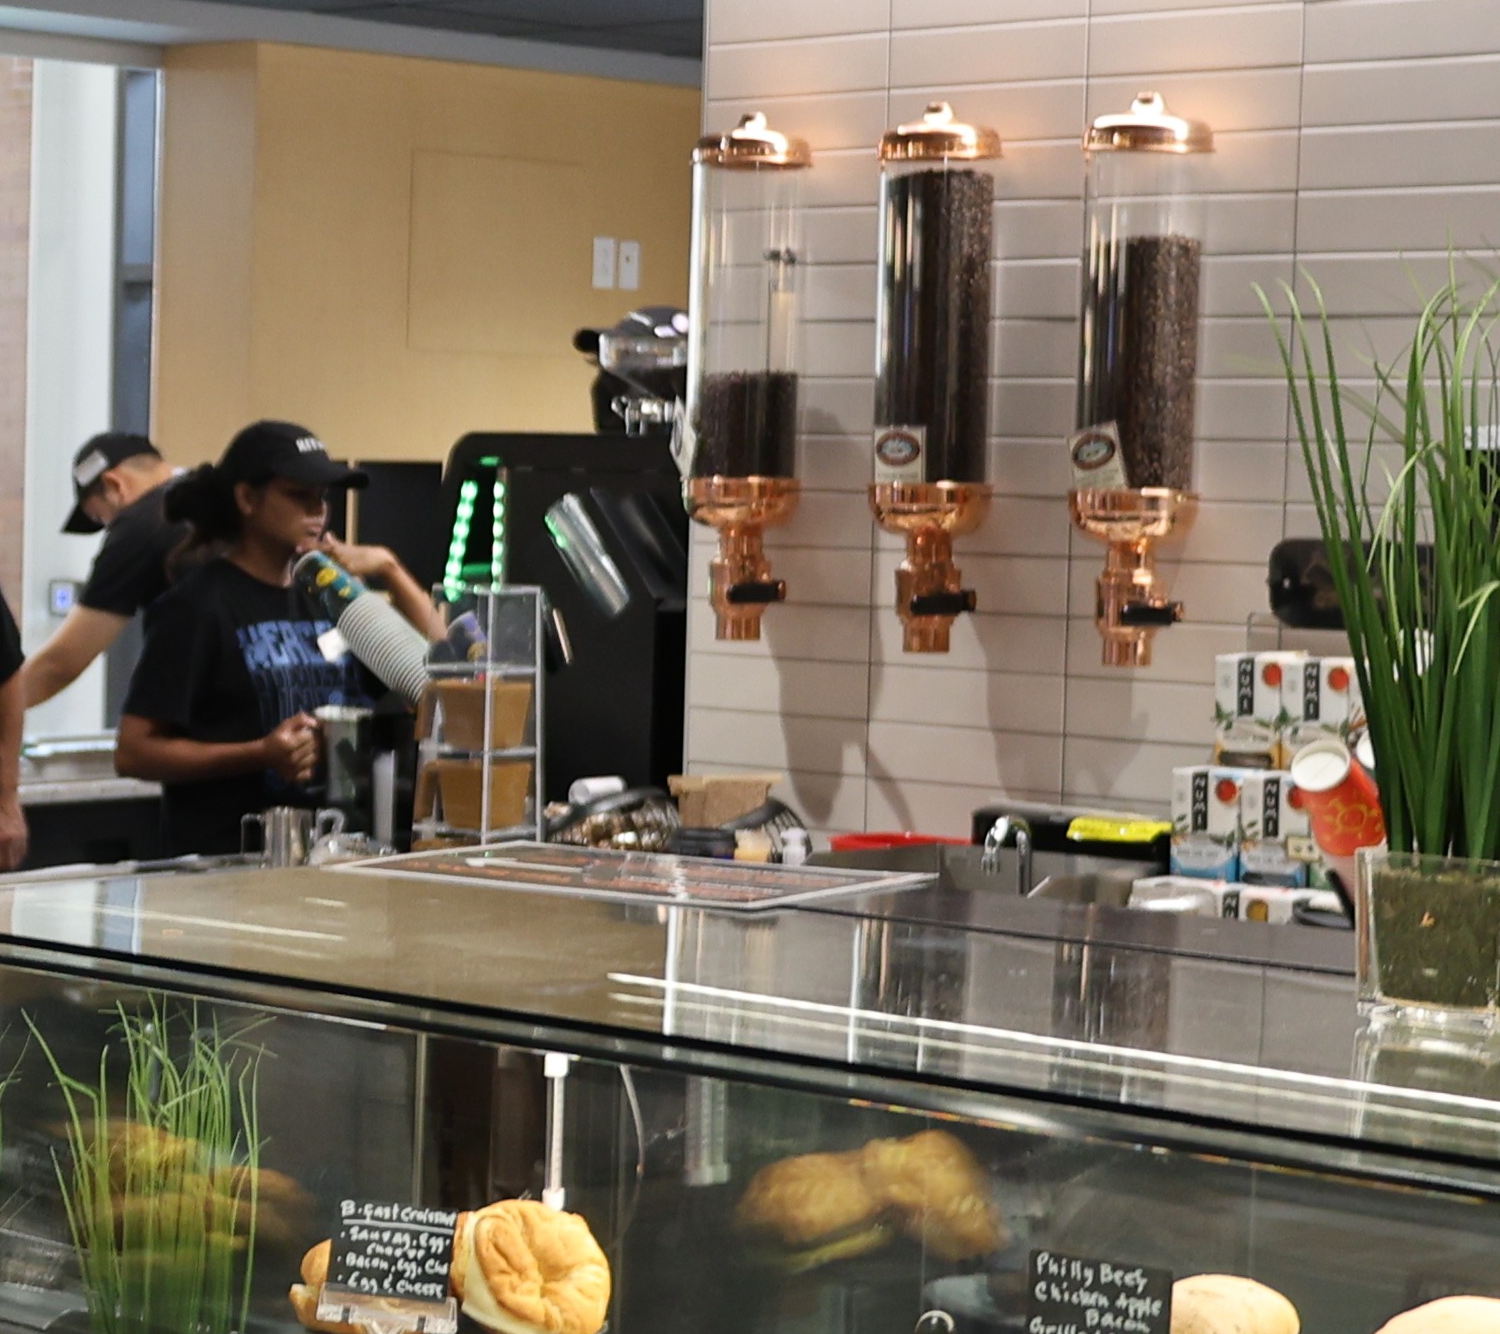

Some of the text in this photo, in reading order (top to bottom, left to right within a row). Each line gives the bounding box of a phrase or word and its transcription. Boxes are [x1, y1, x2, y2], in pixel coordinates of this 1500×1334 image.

[1239, 658, 1254, 713] NUMI
[1306, 663, 1319, 717] NUMI
[1193, 773, 1207, 828] NUMI
[1265, 779, 1278, 835] NUMI
[1034, 1280, 1163, 1319] Chicken Apple
[1036, 1251, 1147, 1294] Philly Beef
[1085, 1308, 1151, 1334] Bacon
